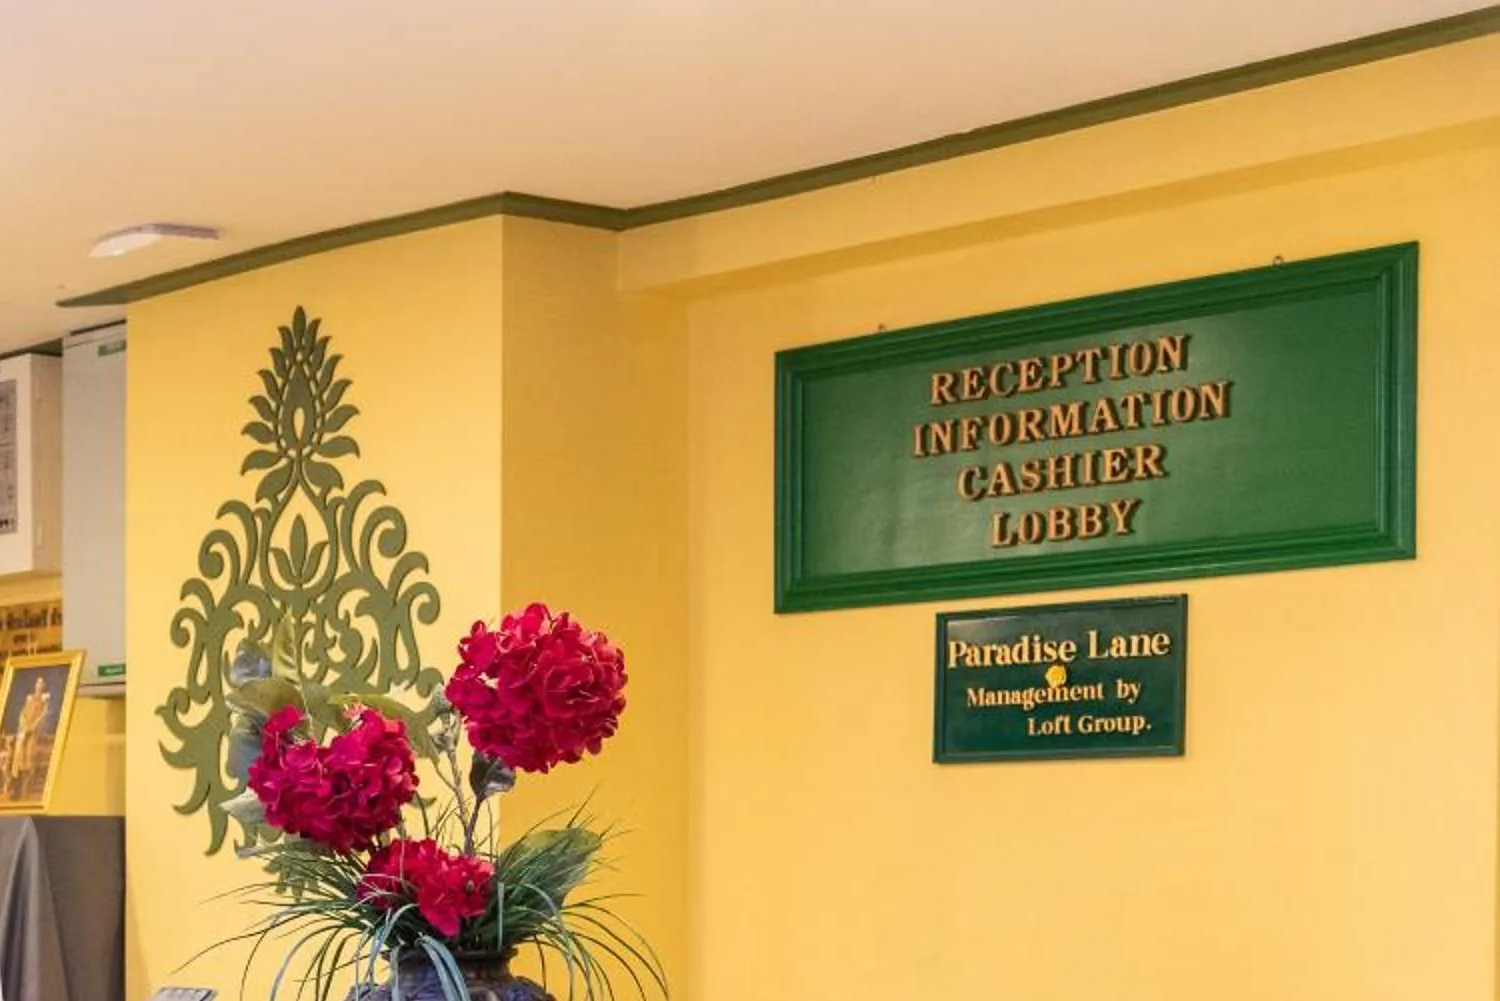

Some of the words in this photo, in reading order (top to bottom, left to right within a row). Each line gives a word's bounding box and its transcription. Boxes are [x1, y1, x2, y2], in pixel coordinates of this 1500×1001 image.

[931, 335, 1187, 406] RECEPTION
[912, 380, 1229, 457] INFORMATION
[957, 444, 1167, 501] CASHIER
[991, 499, 1139, 548] LOBBY
[948, 633, 1077, 668] Paradise
[1086, 629, 1171, 659] Lane
[967, 682, 1105, 711] Management
[1116, 679, 1141, 704] by
[1027, 713, 1072, 736] Loft
[1078, 714, 1153, 735] Group.
